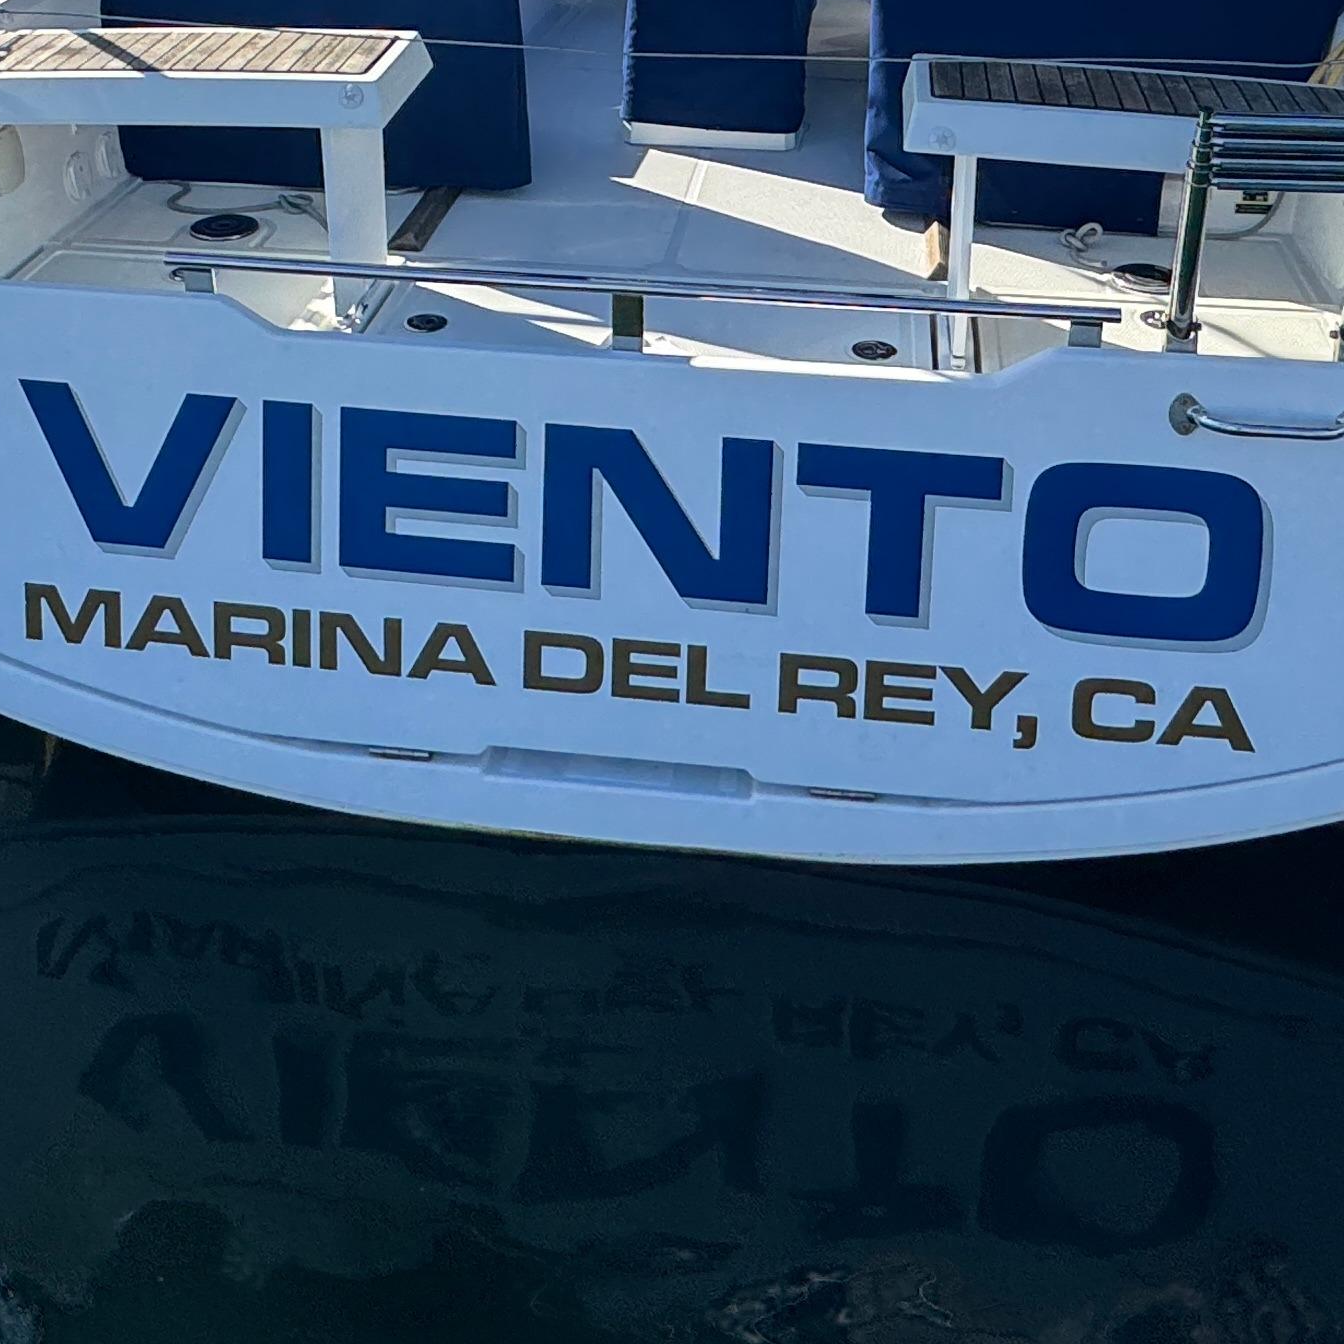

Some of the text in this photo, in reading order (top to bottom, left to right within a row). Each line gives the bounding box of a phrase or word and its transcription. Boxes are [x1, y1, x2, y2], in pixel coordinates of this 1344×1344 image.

[18, 378, 1274, 654] VIENTO
[24, 582, 1257, 754] MARINA DEL REY, CA
